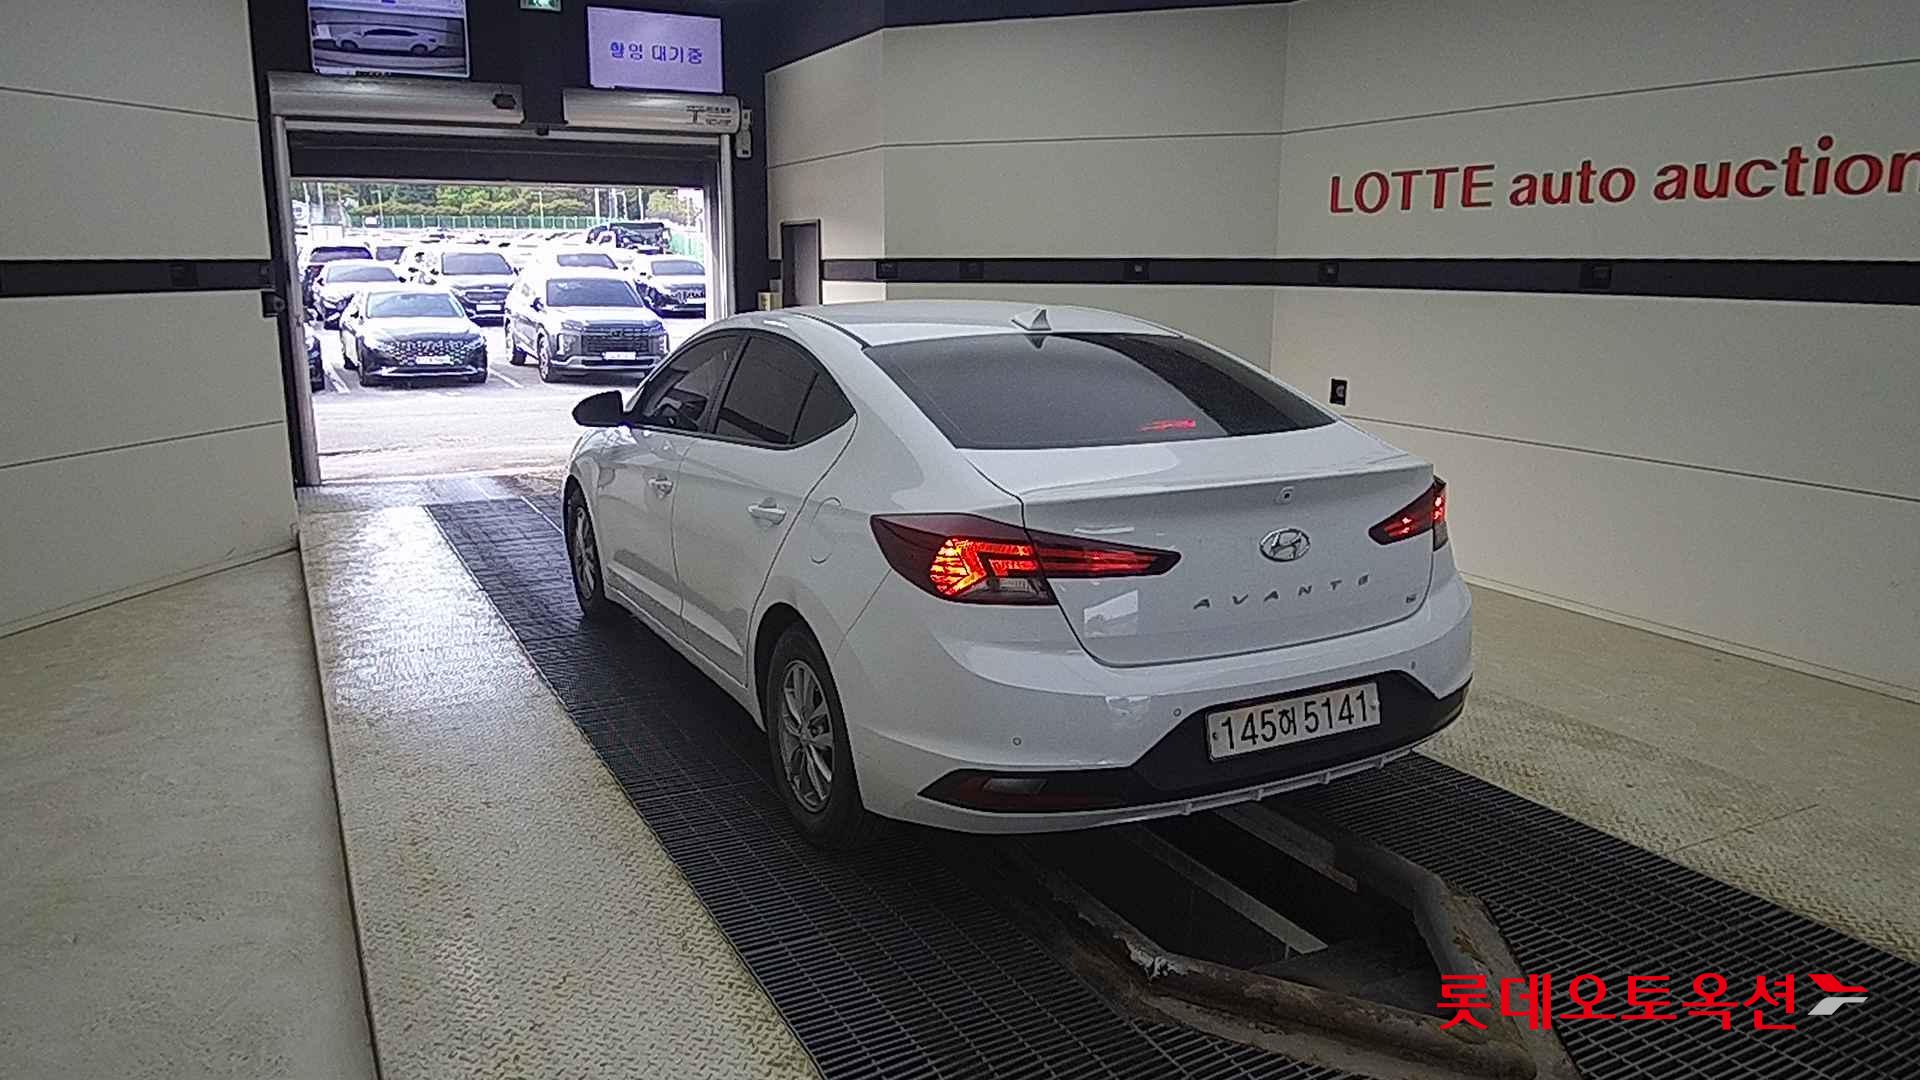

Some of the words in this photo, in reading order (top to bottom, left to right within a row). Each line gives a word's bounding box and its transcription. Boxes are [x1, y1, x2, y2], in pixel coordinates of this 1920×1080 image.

[651, 44, 703, 65] 대기중
[1330, 163, 1496, 214] LOTTE
[1510, 160, 1636, 207] auto
[1192, 573, 1370, 610] AVANTE
